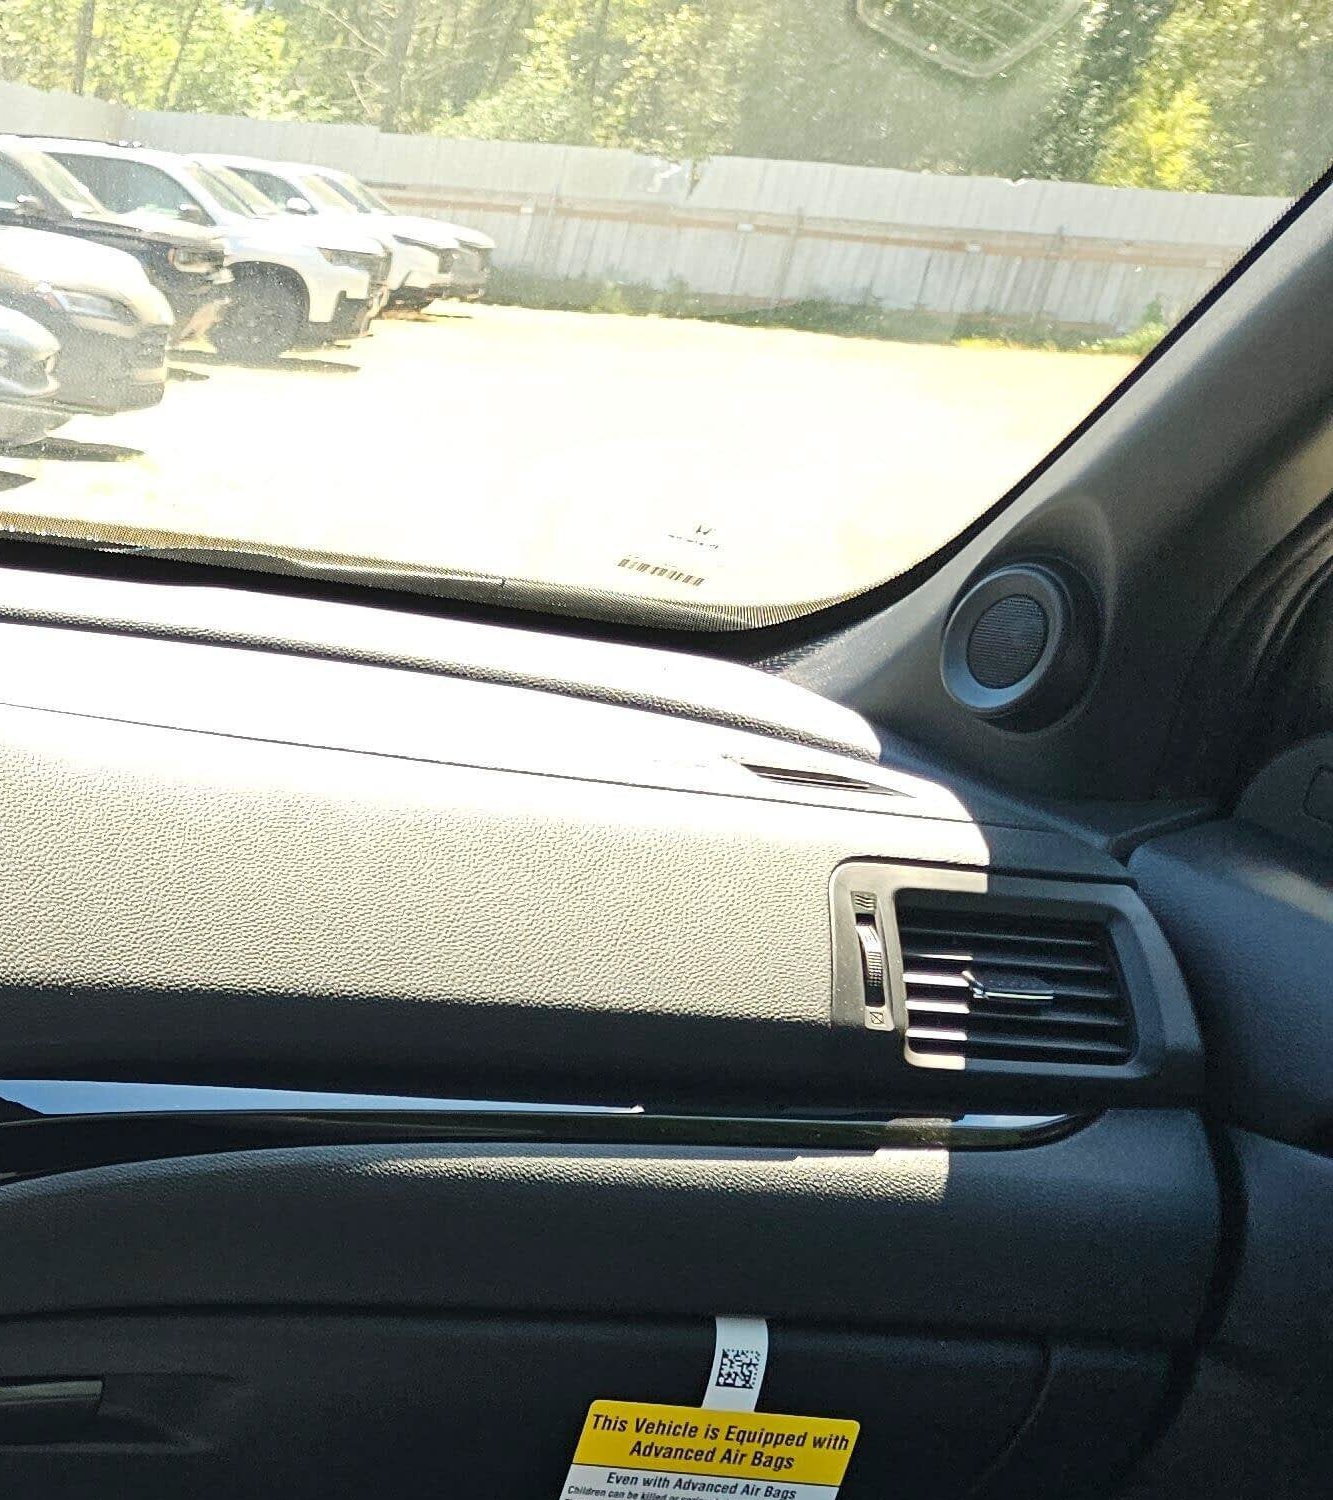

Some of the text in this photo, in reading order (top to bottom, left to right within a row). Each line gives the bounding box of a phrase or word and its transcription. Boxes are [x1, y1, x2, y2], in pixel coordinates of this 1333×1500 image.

[593, 1414, 849, 1450] This Vehicle is Equipped with
[629, 1441, 795, 1471] Advanced Air Bags
[568, 1486, 606, 1497] Children
[608, 1490, 625, 1499] can
[626, 1490, 639, 1500] be
[607, 1472, 797, 1500] Even with Advanced Air Bags
